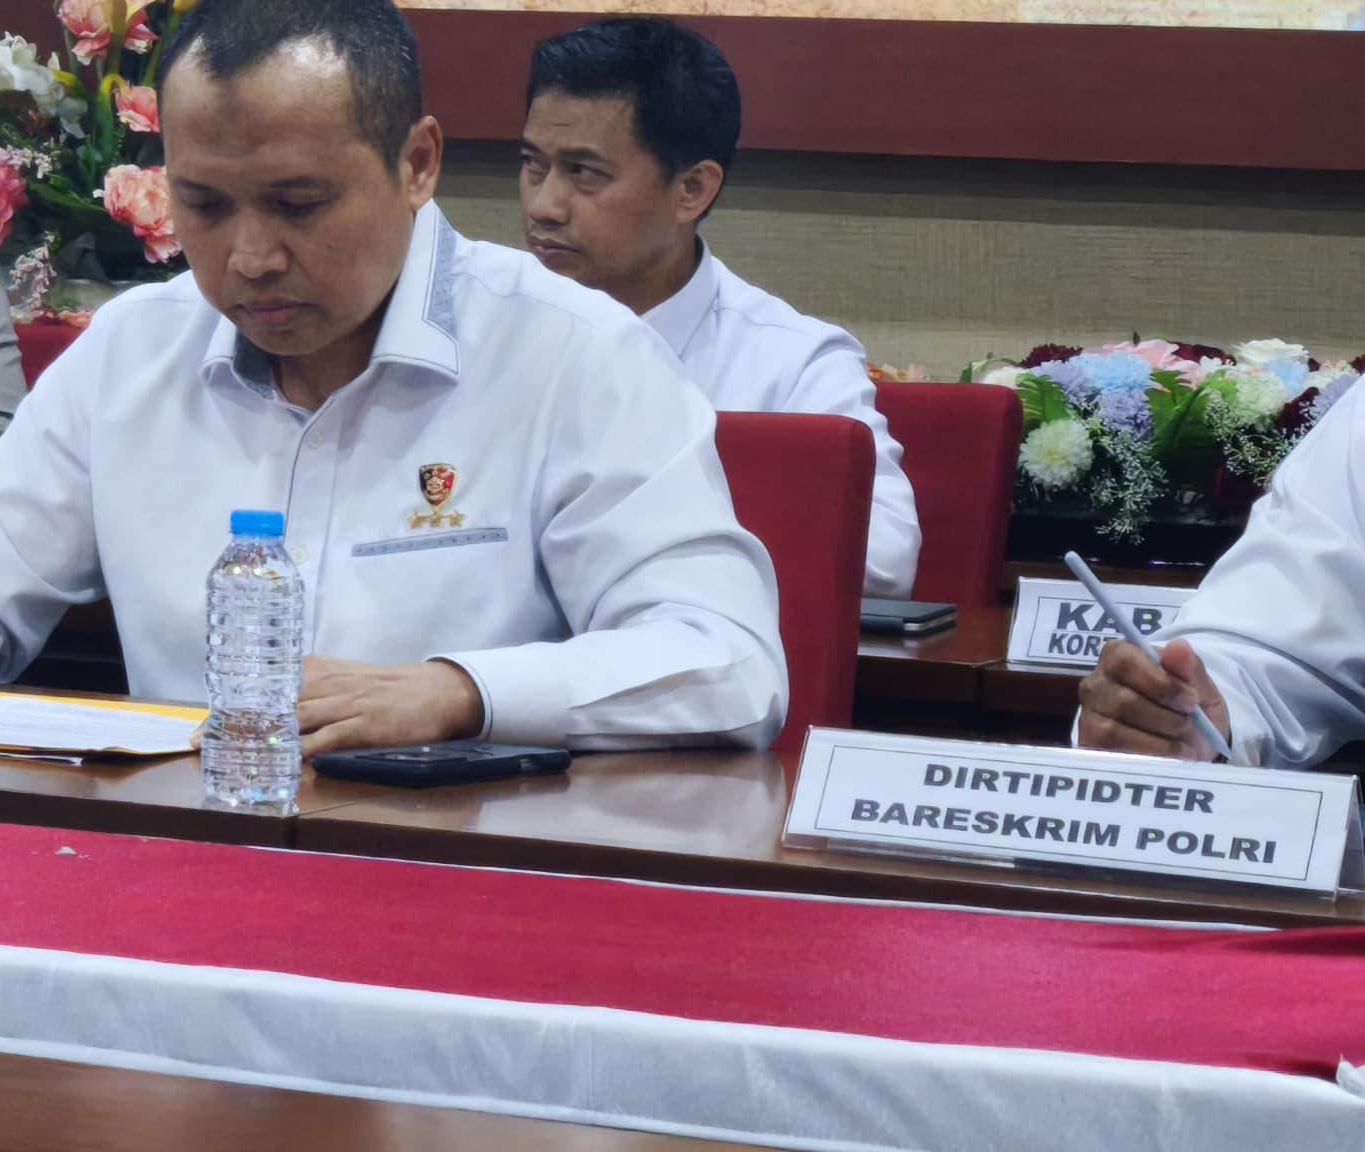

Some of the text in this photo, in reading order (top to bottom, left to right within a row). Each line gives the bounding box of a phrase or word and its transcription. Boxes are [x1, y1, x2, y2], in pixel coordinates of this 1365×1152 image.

[923, 763, 1215, 814] DIRTIPIDTER
[851, 799, 1277, 864] BARESKRIM POLRI
